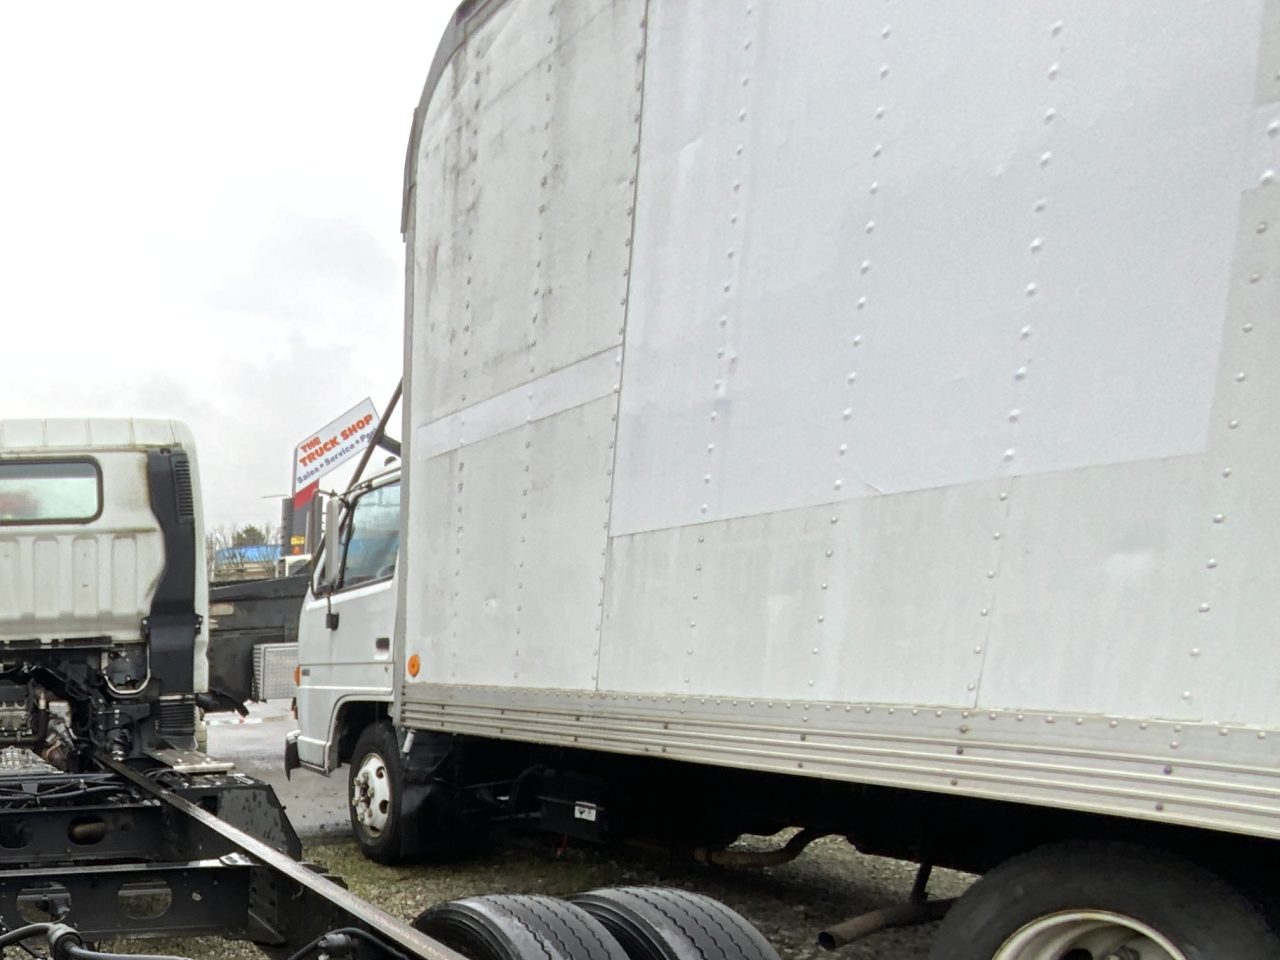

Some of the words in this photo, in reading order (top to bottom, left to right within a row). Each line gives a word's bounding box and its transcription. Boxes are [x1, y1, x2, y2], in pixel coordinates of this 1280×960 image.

[299, 436, 339, 466] TRUCK
[340, 414, 373, 440] SHOP
[297, 467, 320, 484] Sales
[324, 444, 355, 466] Service
